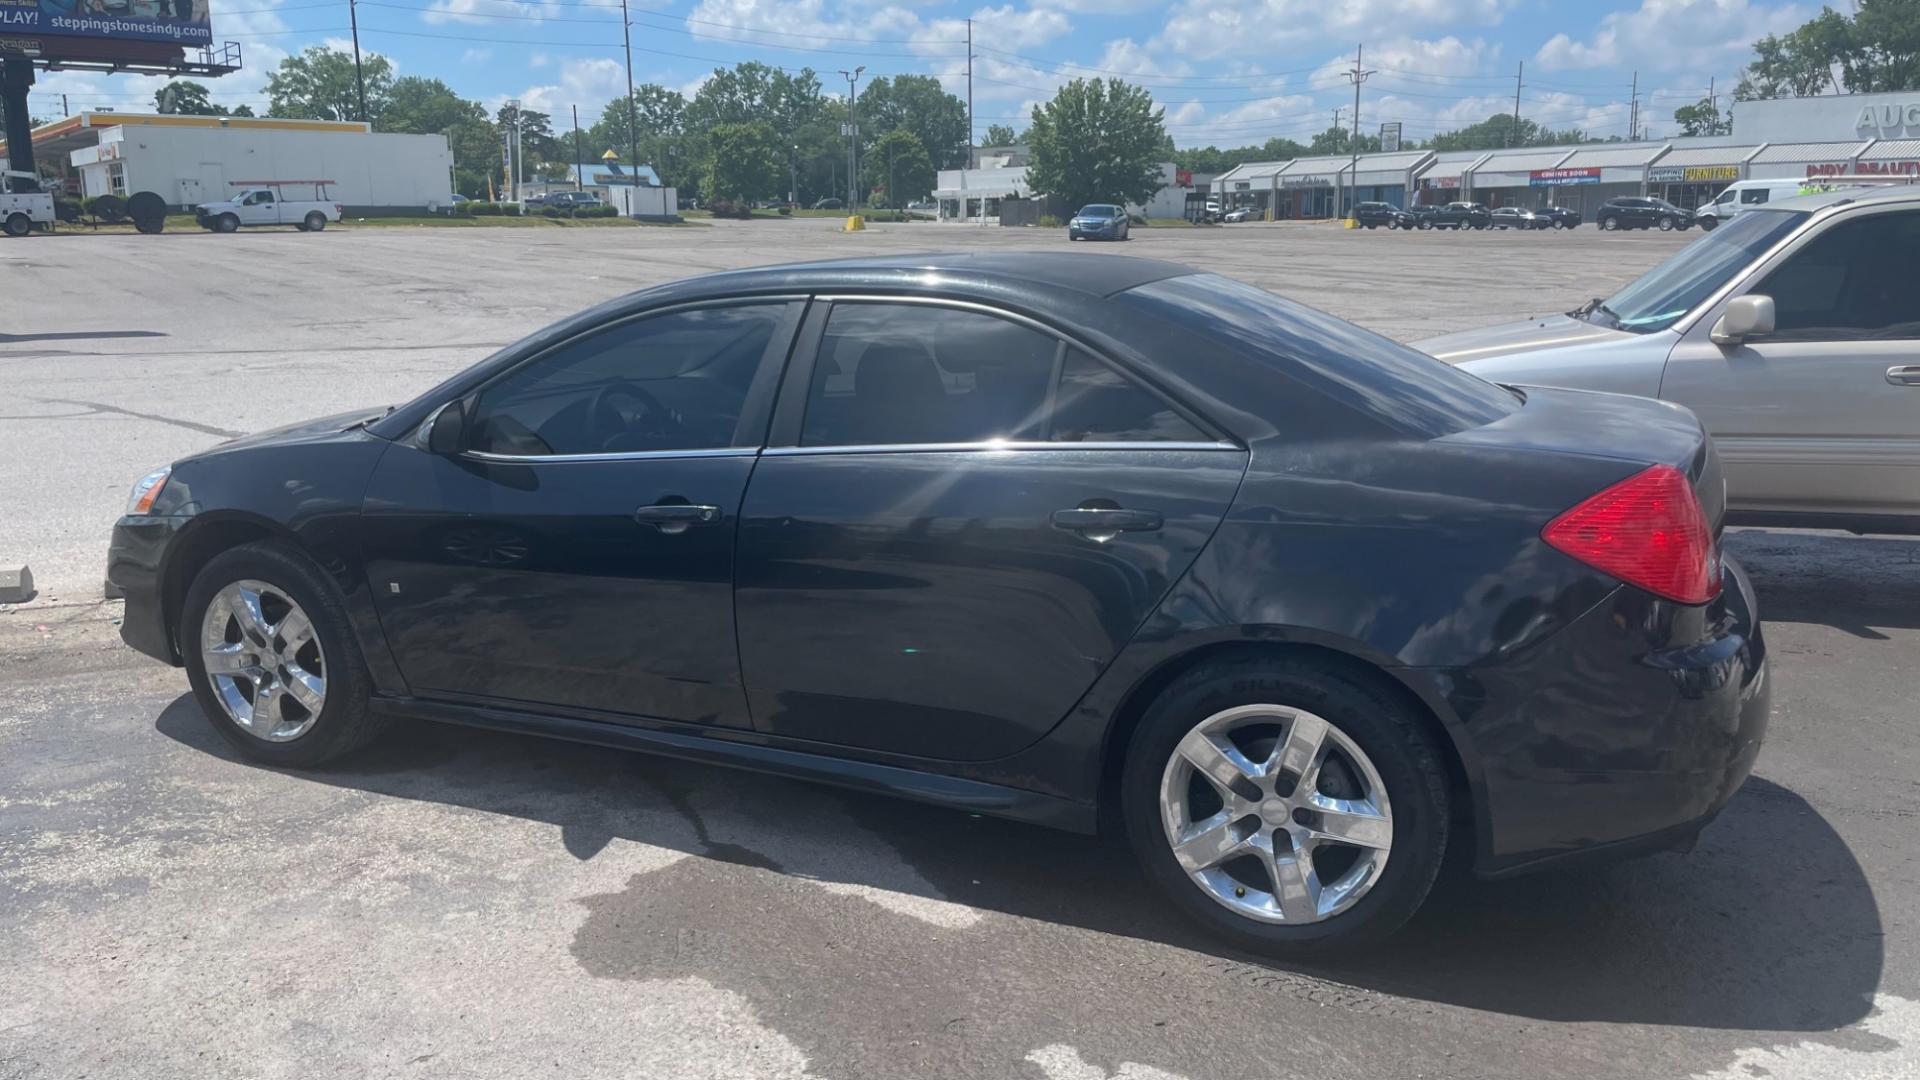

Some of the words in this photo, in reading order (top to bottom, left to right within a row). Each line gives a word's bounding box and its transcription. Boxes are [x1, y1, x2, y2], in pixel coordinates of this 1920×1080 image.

[51, 15, 210, 38] steppingstonesindy.com
[1649, 168, 1682, 176] SHOPPING
[1685, 167, 1738, 179] FURNITURE
[1807, 163, 1849, 177] INDY
